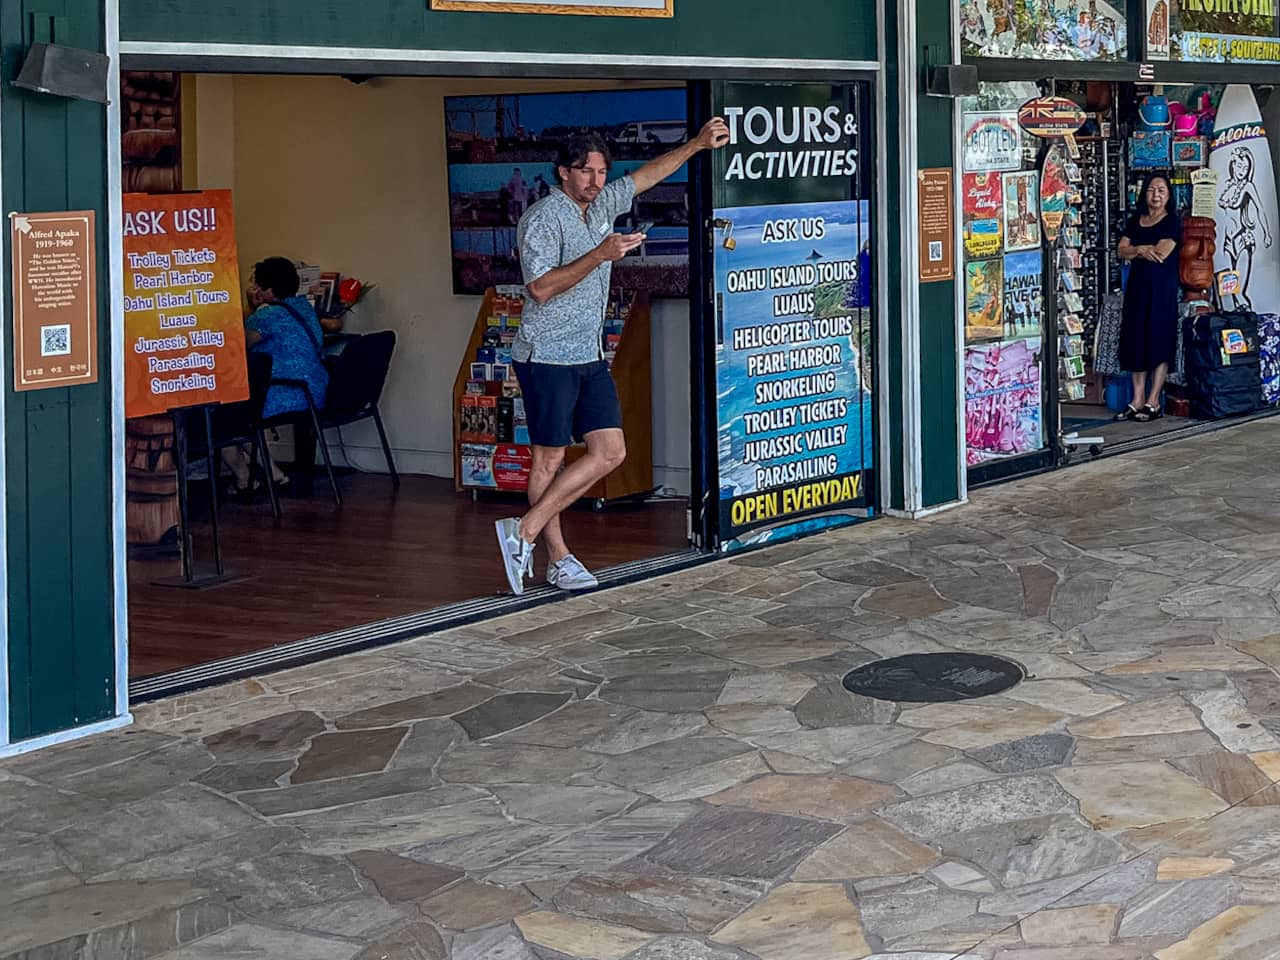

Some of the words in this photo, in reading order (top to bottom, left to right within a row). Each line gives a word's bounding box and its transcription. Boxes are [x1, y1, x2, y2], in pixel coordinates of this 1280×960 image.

[1215, 124, 1261, 146] Aloha
[724, 150, 858, 180] ACTIVITIES
[29, 230, 53, 239] Alfred
[55, 229, 79, 239] Apaka
[124, 211, 167, 236] ASK
[174, 208, 216, 232] US!!
[762, 219, 798, 243] ASK
[802, 218, 824, 239] US
[128, 252, 170, 269] Trolley
[172, 248, 216, 265] Tickets
[134, 272, 167, 289] Pearl
[170, 269, 214, 286] Harbor
[727, 268, 766, 292] OAHU
[770, 265, 815, 289] ISLAND
[818, 260, 857, 284] TOURS
[124, 297, 153, 311] Oahu
[156, 291, 191, 308] Island
[195, 289, 229, 304] Tours
[774, 293, 814, 316] LUAUS
[160, 314, 196, 329] Luaus
[734, 321, 810, 350] HELICOPTER
[813, 316, 852, 339] TOURS
[135, 335, 187, 353] Jurassic
[190, 330, 224, 347] Valley
[148, 353, 215, 372] Parasailing
[748, 352, 787, 376] PEARL
[790, 345, 841, 370] HARBOR
[151, 373, 216, 393] Snorkeling
[755, 373, 836, 404] SNORKELING
[744, 406, 799, 434] TROLLEY
[801, 398, 847, 423] TICKETS
[744, 433, 802, 463] JURASSIC
[806, 425, 848, 450] VALLEY
[756, 454, 837, 489] PARASAILING
[731, 493, 778, 526] OPEN
[783, 474, 861, 514] EVERYDAY
